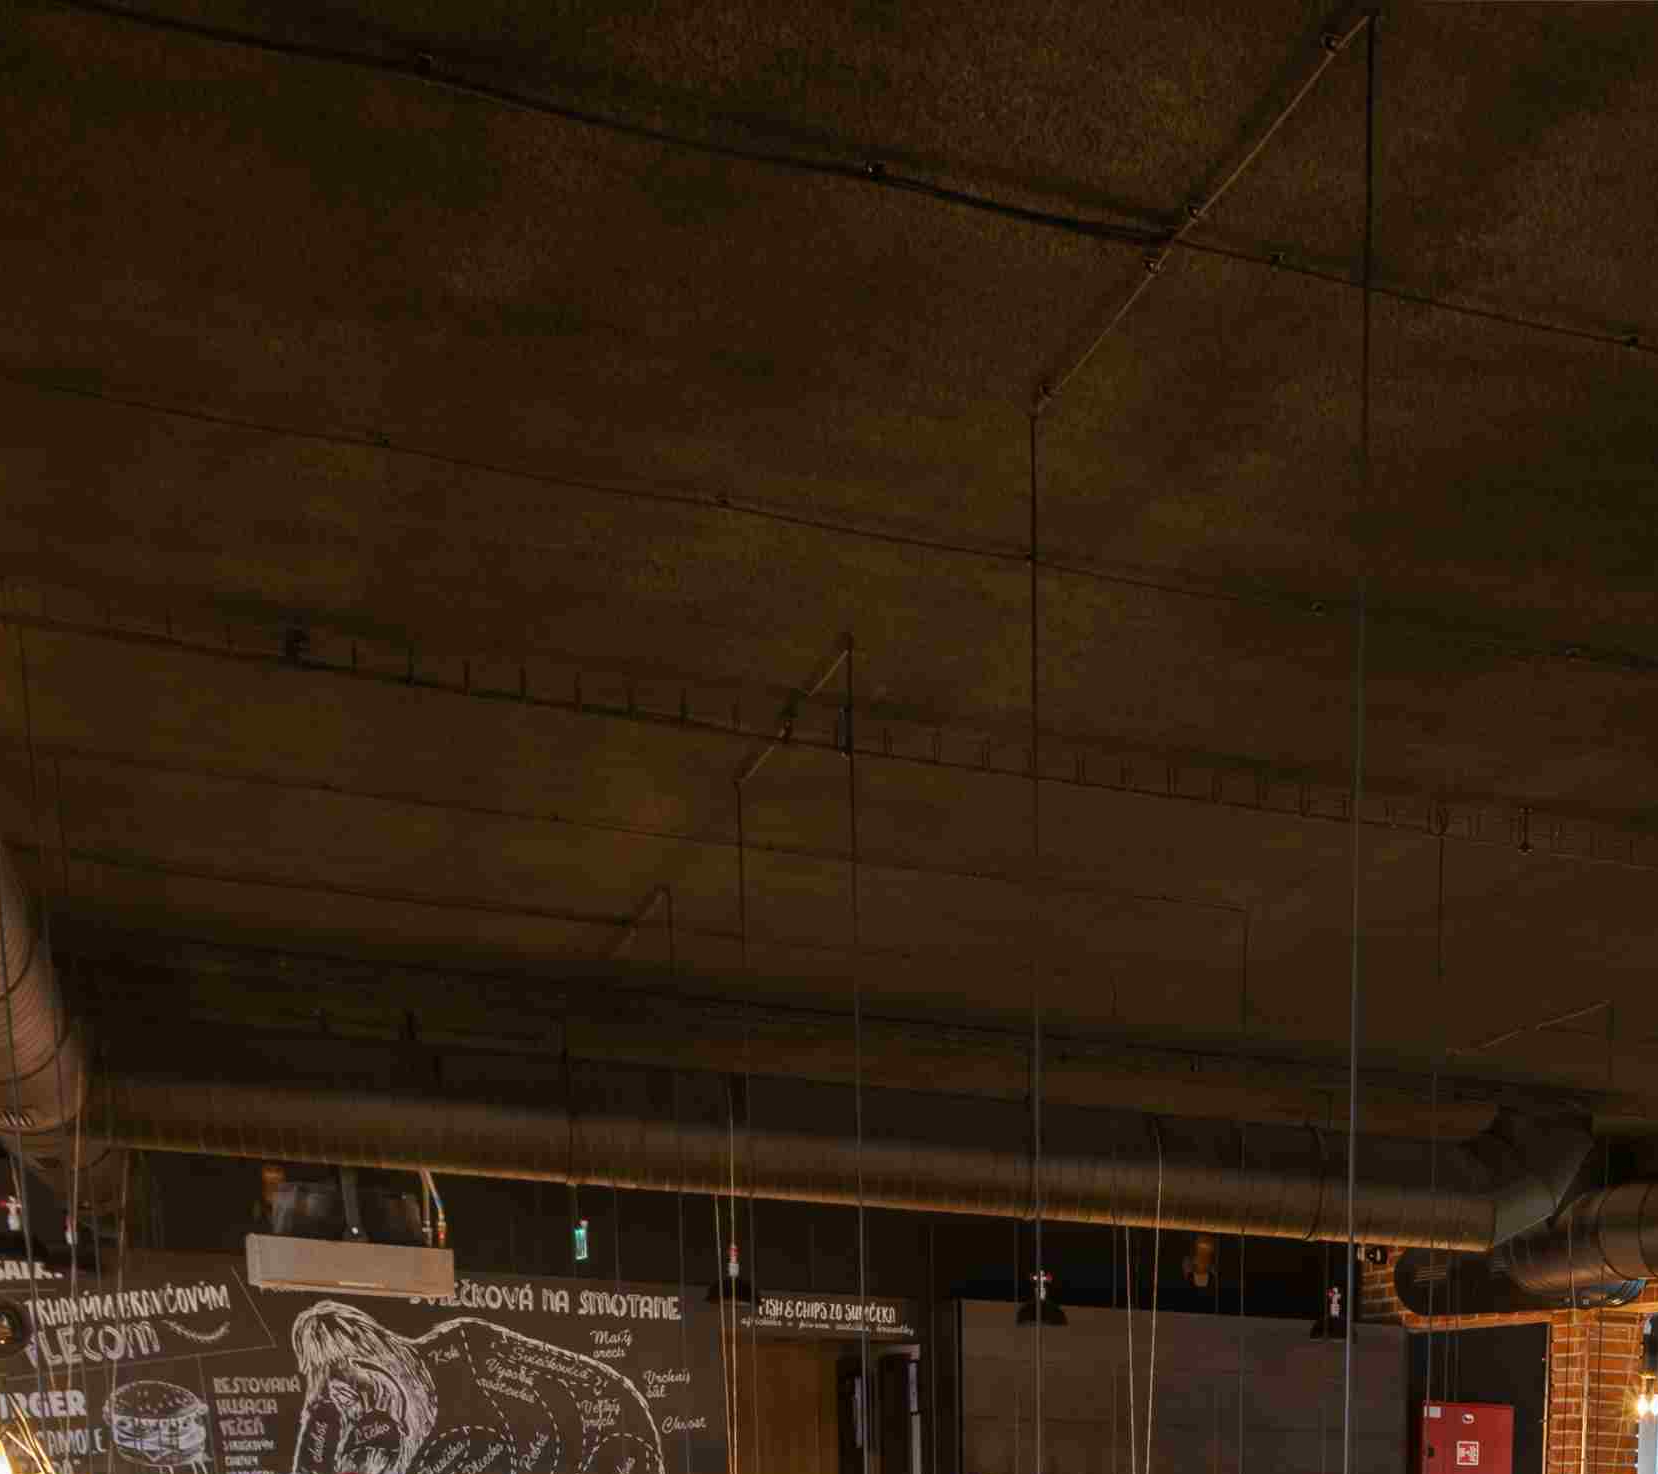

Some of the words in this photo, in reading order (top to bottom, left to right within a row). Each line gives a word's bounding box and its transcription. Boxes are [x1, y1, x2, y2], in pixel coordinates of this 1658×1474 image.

[542, 1287, 570, 1314] NA
[578, 1289, 682, 1321] SMOTANE
[795, 1301, 828, 1320] CHIPS
